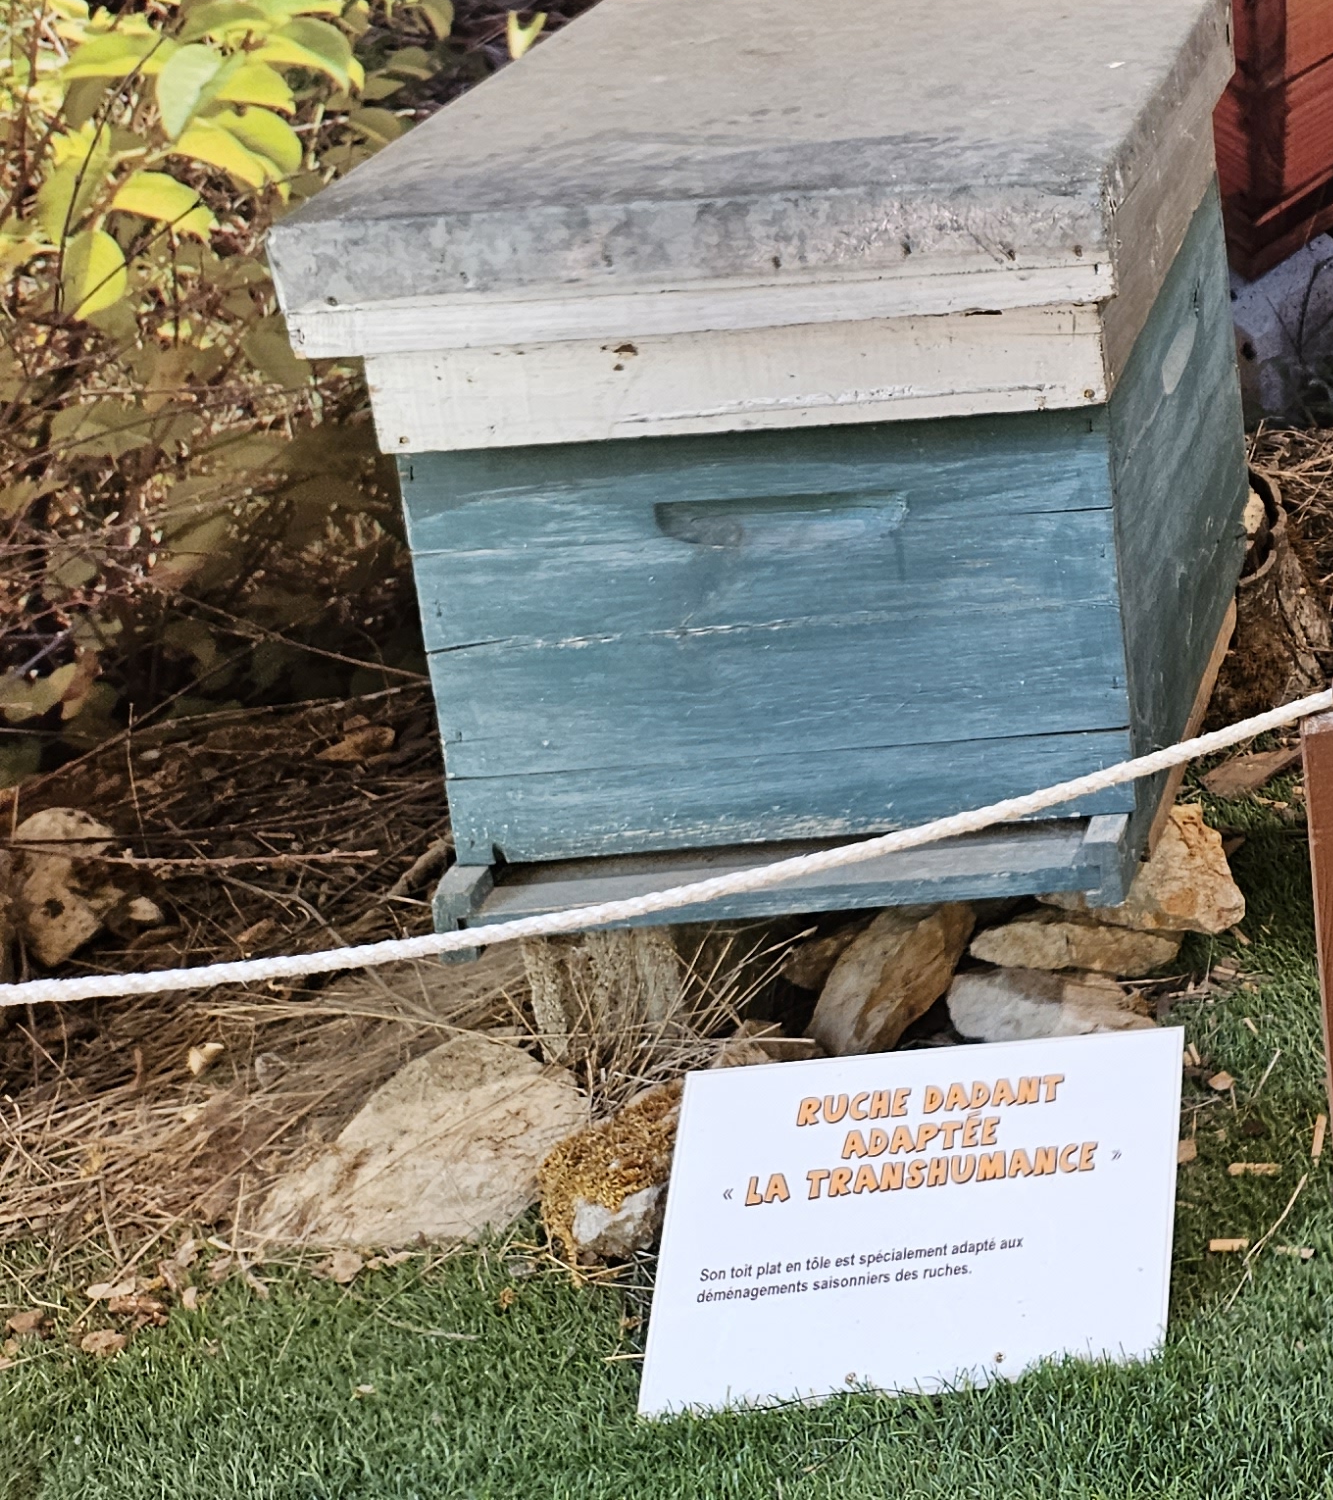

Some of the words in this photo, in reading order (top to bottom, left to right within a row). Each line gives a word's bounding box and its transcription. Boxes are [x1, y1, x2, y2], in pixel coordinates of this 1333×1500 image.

[797, 1087, 911, 1127] RUCHE
[922, 1073, 1066, 1114] DADANT
[840, 1110, 1001, 1160] ADAPTÉE
[745, 1173, 791, 1206] LA
[806, 1141, 1099, 1200] TRANSHUMANCE
[696, 1280, 808, 1304] déménagements
[812, 1271, 891, 1291] saisonniers
[895, 1268, 919, 1282] des
[923, 1263, 973, 1280] ruches.
[699, 1268, 726, 1282] Son
[731, 1263, 752, 1279] toit
[756, 1261, 782, 1280] plat
[786, 1261, 801, 1273] en
[806, 1256, 831, 1271] tôle
[835, 1253, 855, 1268] est
[859, 1243, 948, 1268] spécialement
[951, 1237, 996, 1256] adapté
[1000, 1237, 1024, 1250] aux
